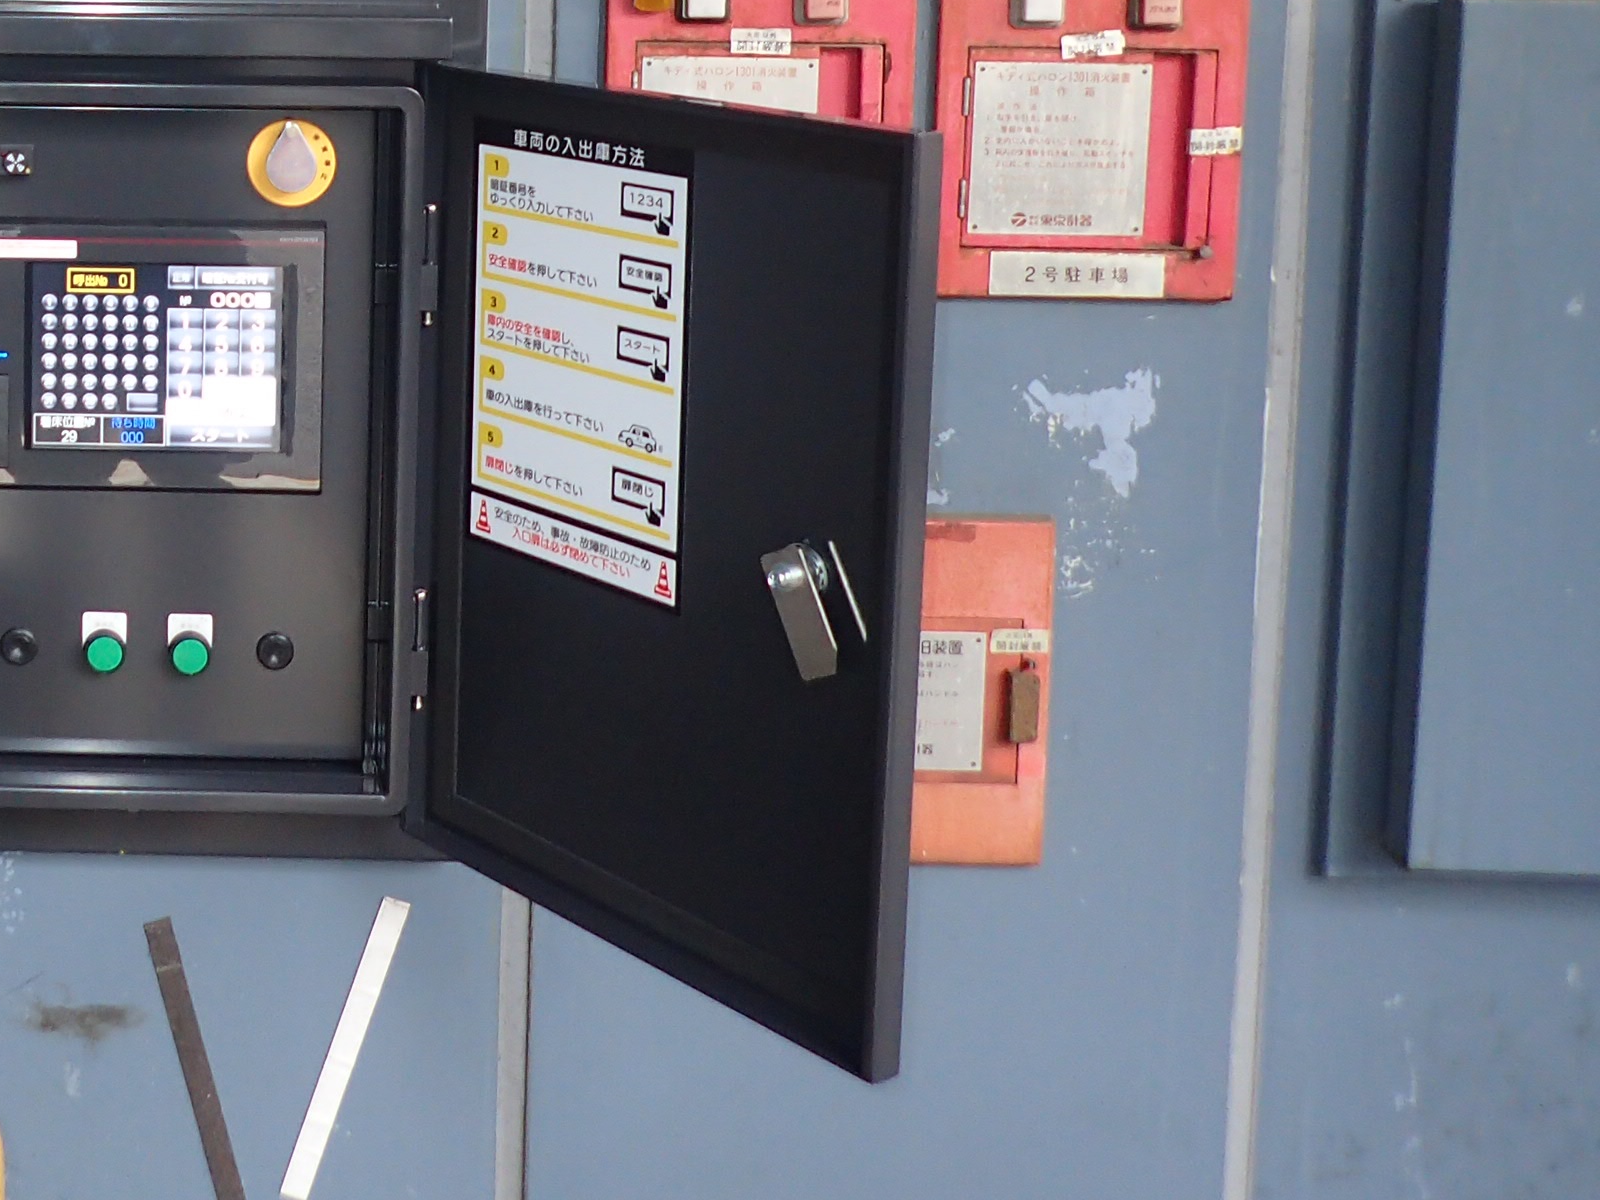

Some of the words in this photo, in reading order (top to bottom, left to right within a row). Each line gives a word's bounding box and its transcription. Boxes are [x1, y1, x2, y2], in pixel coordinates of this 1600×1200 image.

[513, 129, 645, 168] 車両の入出庫方法
[493, 159, 500, 170] 1
[490, 193, 594, 222] ゆっくり入力して下さい
[629, 191, 664, 209] 1234
[491, 227, 498, 238] 2
[488, 253, 597, 288] 安全確認を押して下さい
[626, 266, 663, 283] 安全確認
[1025, 266, 1129, 284] 2号駐車場
[118, 274, 128, 287] 0
[490, 296, 497, 307] 3
[487, 328, 590, 364] スタートを押して下さい
[624, 338, 661, 355] スタート
[489, 364, 496, 375] 4
[485, 388, 604, 433] 車の入出庫を行って下さい
[61, 430, 78, 443] 29
[121, 431, 144, 443] 000
[487, 431, 494, 442] 5
[485, 455, 583, 497] 扉閉じを押して下さい
[621, 478, 654, 498] 扉閉じ
